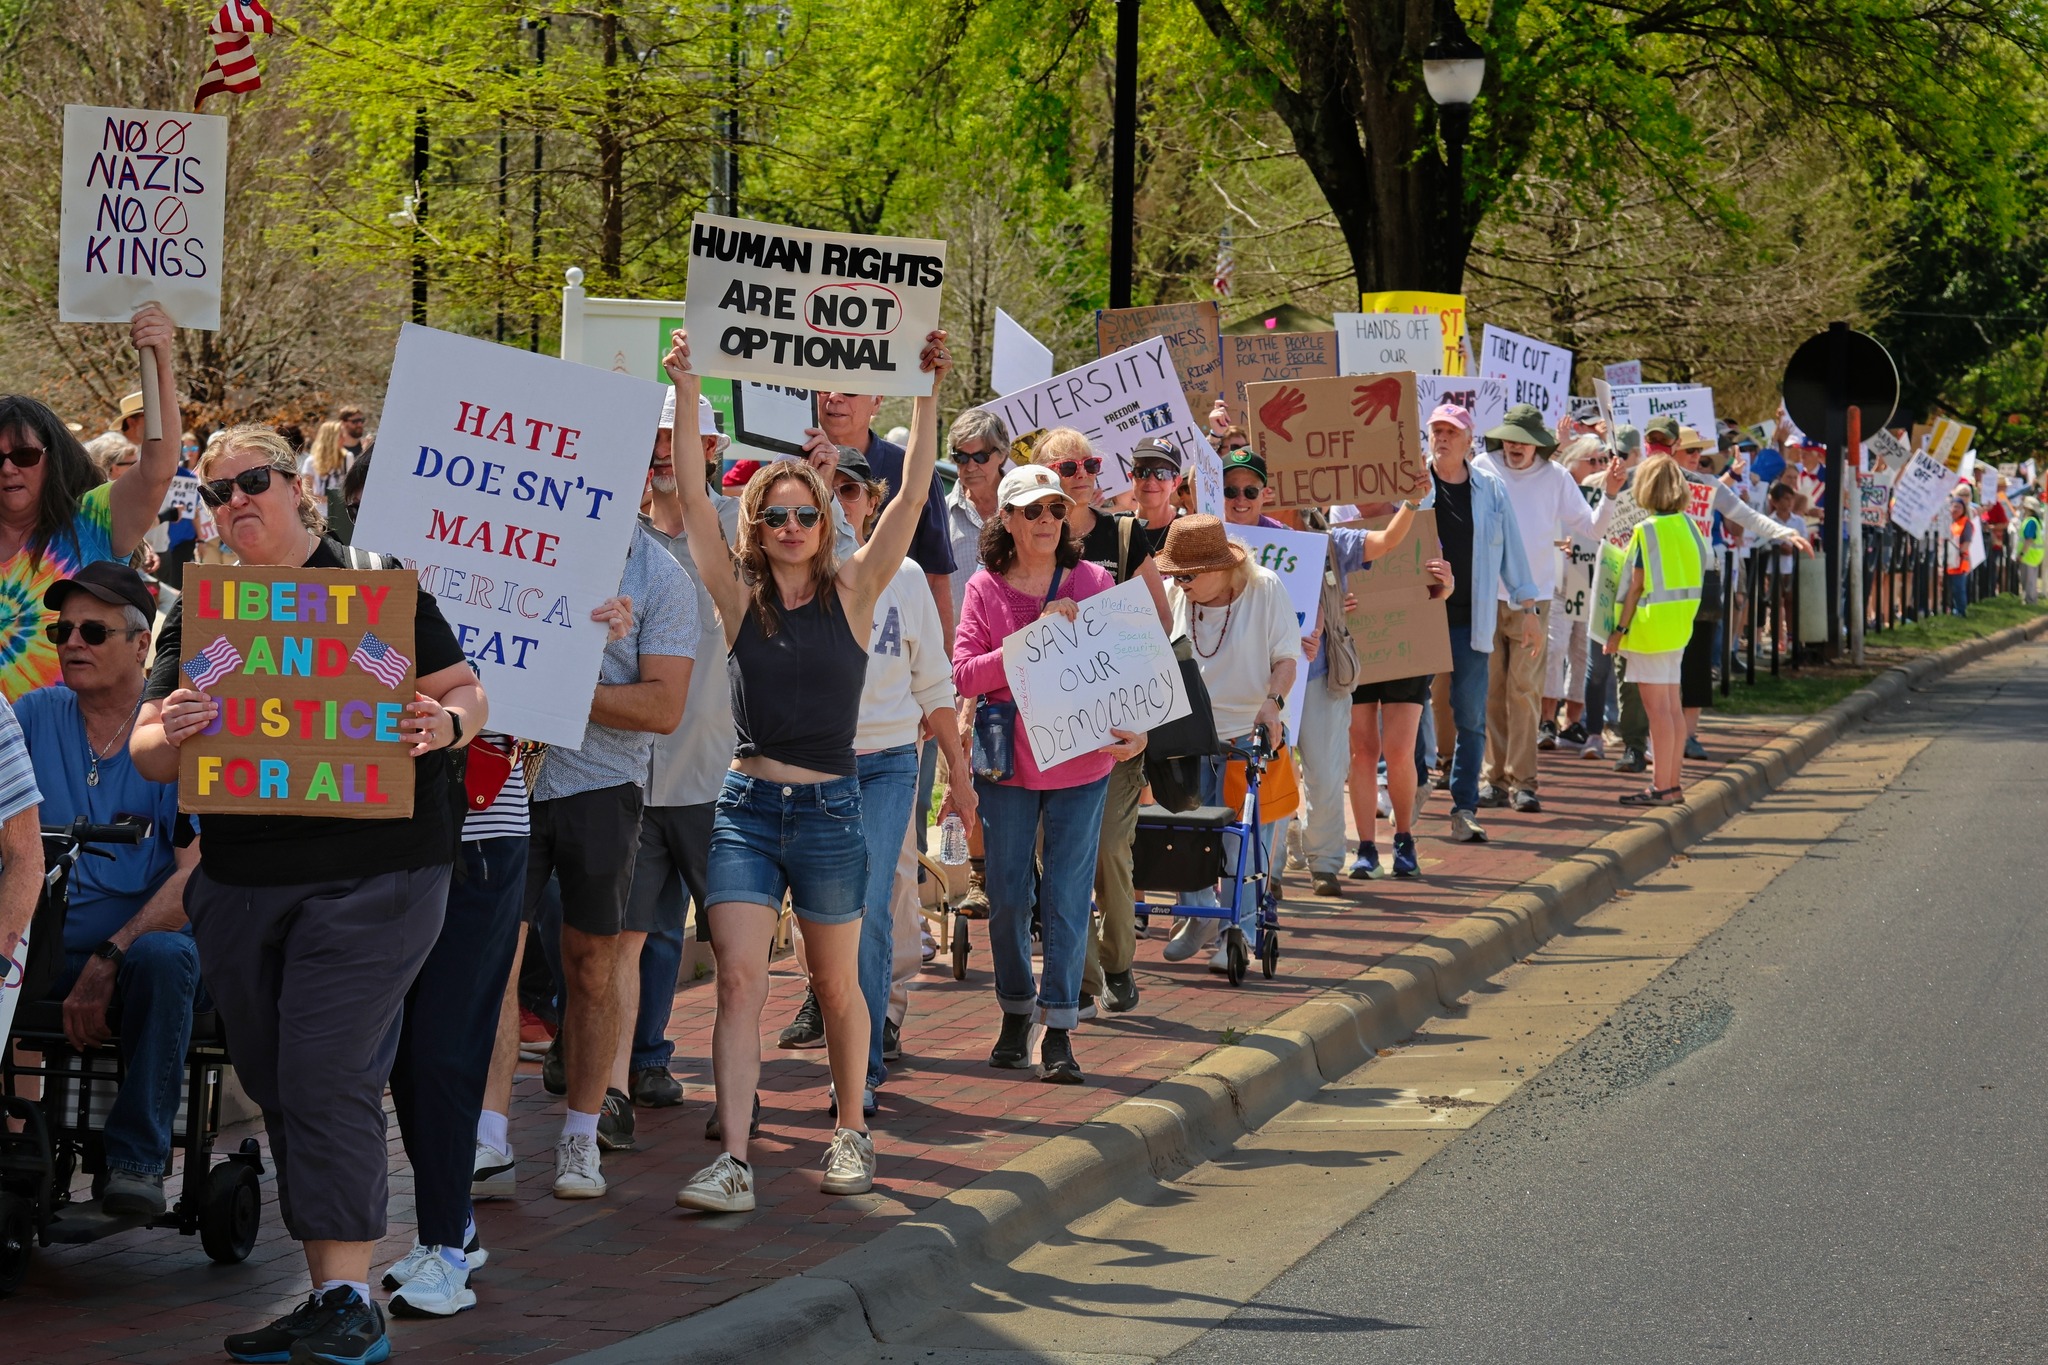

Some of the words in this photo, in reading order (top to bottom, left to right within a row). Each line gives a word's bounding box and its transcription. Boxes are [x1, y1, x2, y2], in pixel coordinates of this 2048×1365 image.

[86, 152, 205, 194] NAZIS
[86, 235, 207, 278] KINGS
[693, 223, 813, 274] HUMAN
[821, 243, 943, 288] RIGHTS
[718, 278, 797, 321] ARE
[812, 294, 895, 330] NOT
[1102, 305, 1200, 334] SOMEWHERE
[719, 326, 897, 371] OPTIONAL
[1234, 337, 1253, 352] BY
[1255, 336, 1279, 350] THE
[1284, 335, 1325, 351] PEOPLE
[1355, 319, 1401, 341] HANDS
[1406, 319, 1430, 341] OFF
[1187, 358, 1221, 379] RIGHTS
[1236, 353, 1260, 367] FOR
[1260, 352, 1282, 365] THE
[1286, 352, 1326, 365] PEOPLE
[1263, 367, 1303, 379] NOT
[1379, 348, 1409, 365] OUR
[1490, 334, 1518, 364] THEY
[1523, 346, 1551, 375] CUT
[1004, 344, 1167, 437] IVERSITY
[1516, 378, 1550, 412] BLEED
[1649, 397, 1688, 415] HANDS
[453, 401, 581, 460] HATE
[1104, 401, 1141, 425] FREEDOM
[1116, 421, 1130, 432] TO
[1130, 415, 1140, 426] BE
[1305, 430, 1355, 460] OFF
[412, 445, 614, 520] DOESN'T
[425, 508, 560, 567] MAKE
[197, 579, 391, 625] LIBERTY
[388, 554, 572, 628] MERICA
[1101, 598, 1153, 614] Medicare
[1565, 590, 1585, 616] of
[1025, 606, 1108, 663] SAVE
[1367, 628, 1390, 640] OUR
[1385, 609, 1408, 623] OFF
[452, 623, 539, 670] EAT
[1113, 642, 1162, 660] Security
[1118, 629, 1155, 641] Social
[242, 636, 349, 678] AND
[1059, 650, 1120, 692] OUR
[200, 696, 403, 742] JUSTICE
[1029, 669, 1174, 765] DEMOCRACY
[198, 756, 290, 799] FOR
[304, 761, 389, 804] ALL
[1151, 906, 1171, 914] drive
